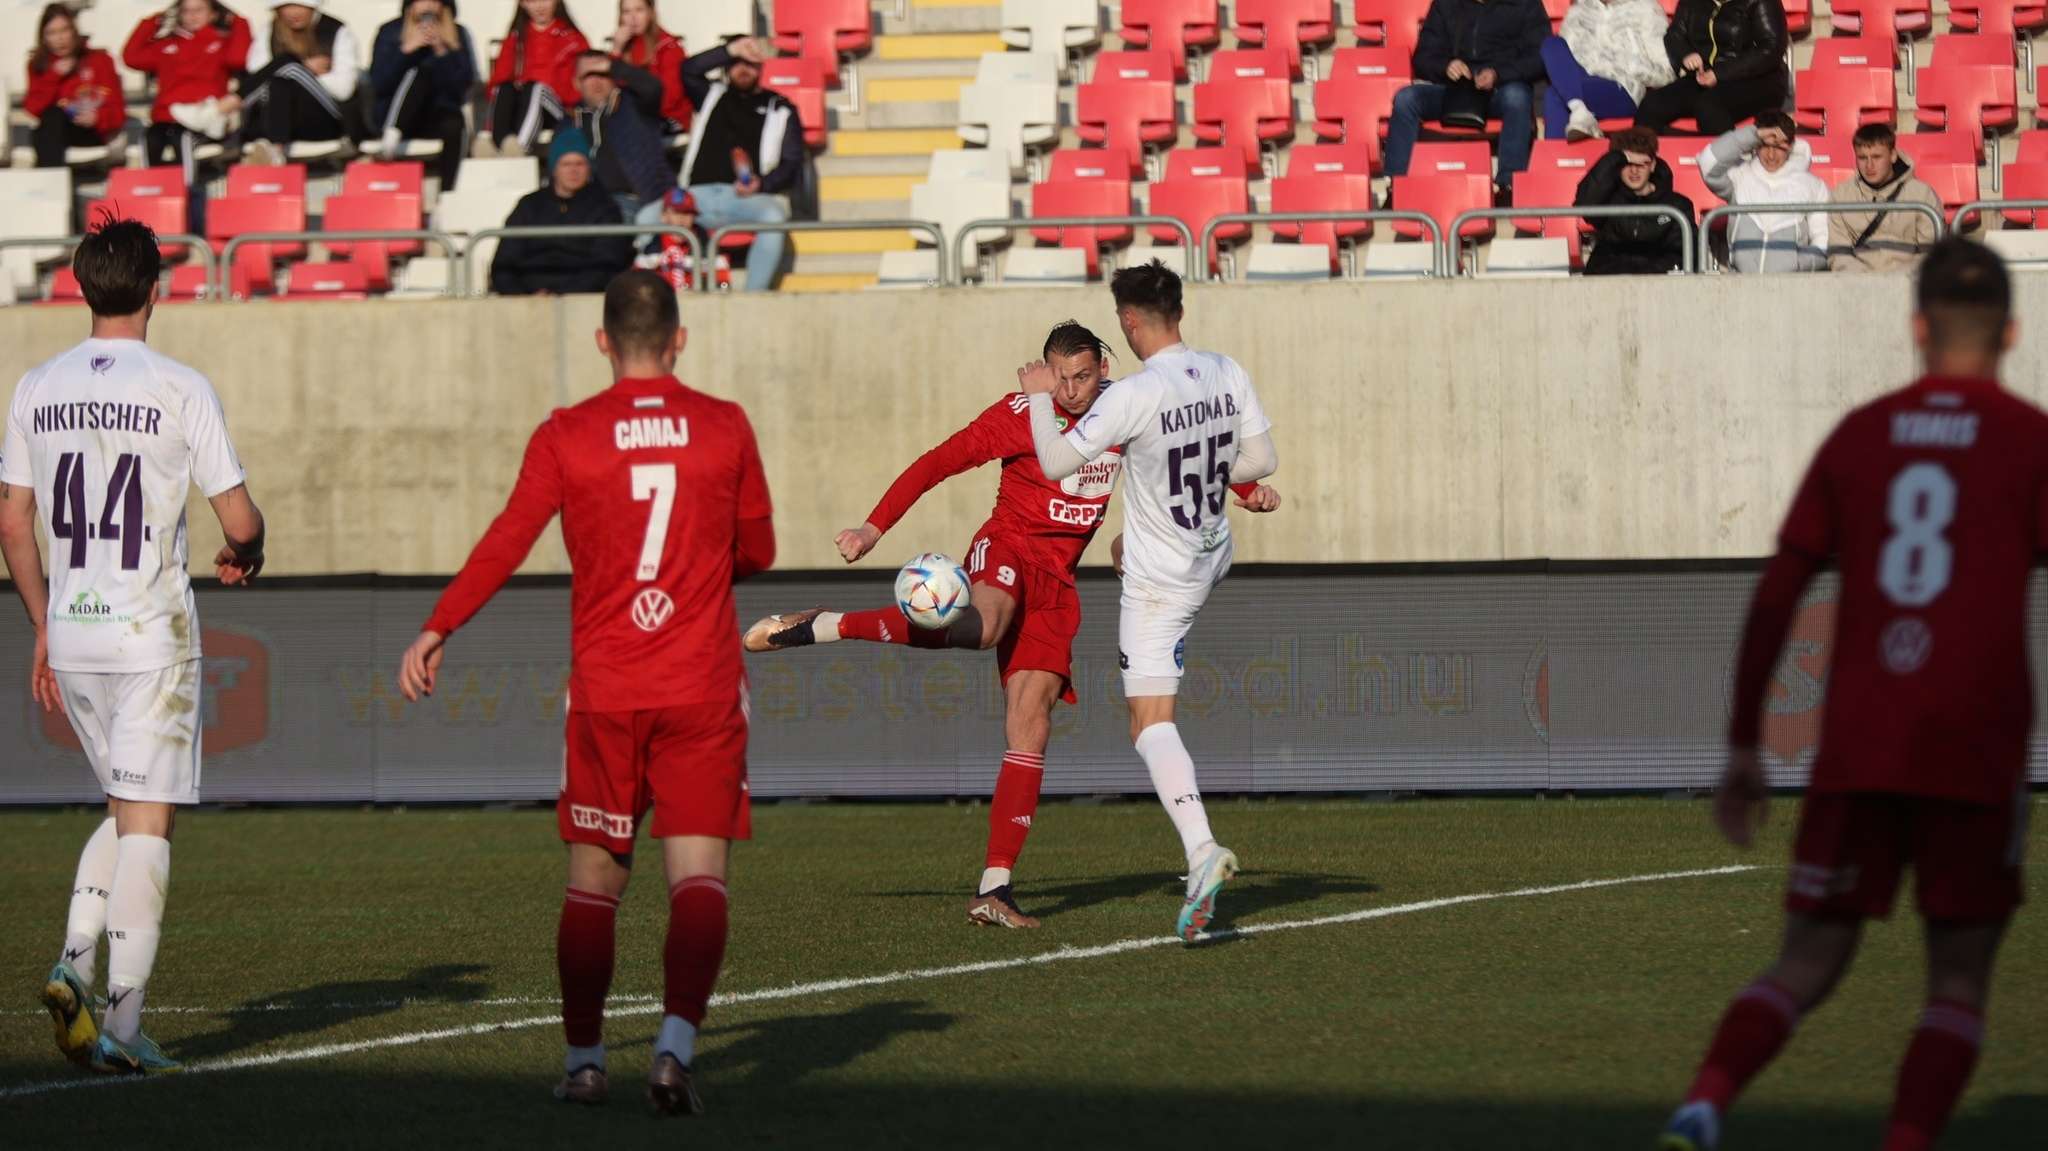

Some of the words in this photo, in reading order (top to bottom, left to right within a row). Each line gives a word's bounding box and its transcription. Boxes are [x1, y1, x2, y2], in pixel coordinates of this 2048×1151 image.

[34, 401, 161, 435] NIKITSCHER
[615, 417, 689, 450] CAMAJ
[51, 452, 151, 570] 44
[1078, 471, 1110, 487] good
[1168, 431, 1233, 530] 55
[630, 463, 677, 581] 7
[1878, 462, 1957, 606] 8
[996, 565, 1016, 586] 9
